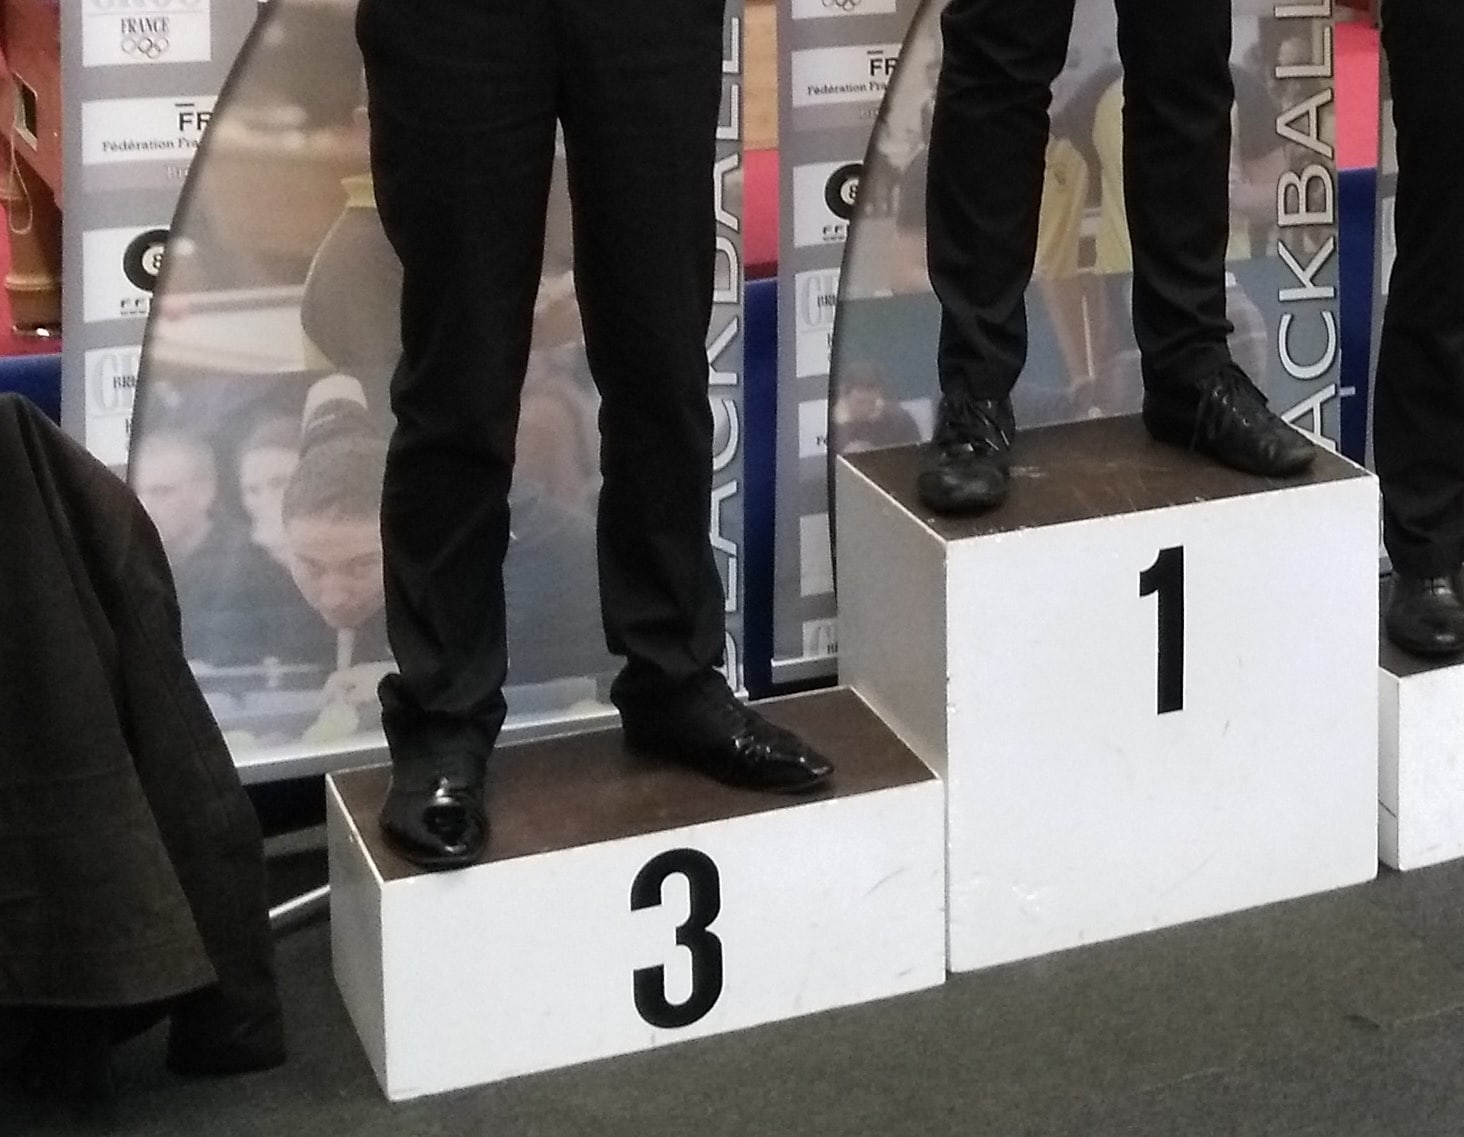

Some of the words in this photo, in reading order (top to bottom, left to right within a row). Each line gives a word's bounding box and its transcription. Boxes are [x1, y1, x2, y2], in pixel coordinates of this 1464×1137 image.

[121, 16, 169, 34] FRANCE
[807, 82, 867, 96] Fédération
[102, 140, 175, 153] Fédération
[1138, 546, 1185, 715] 1
[630, 848, 723, 1029] 3
